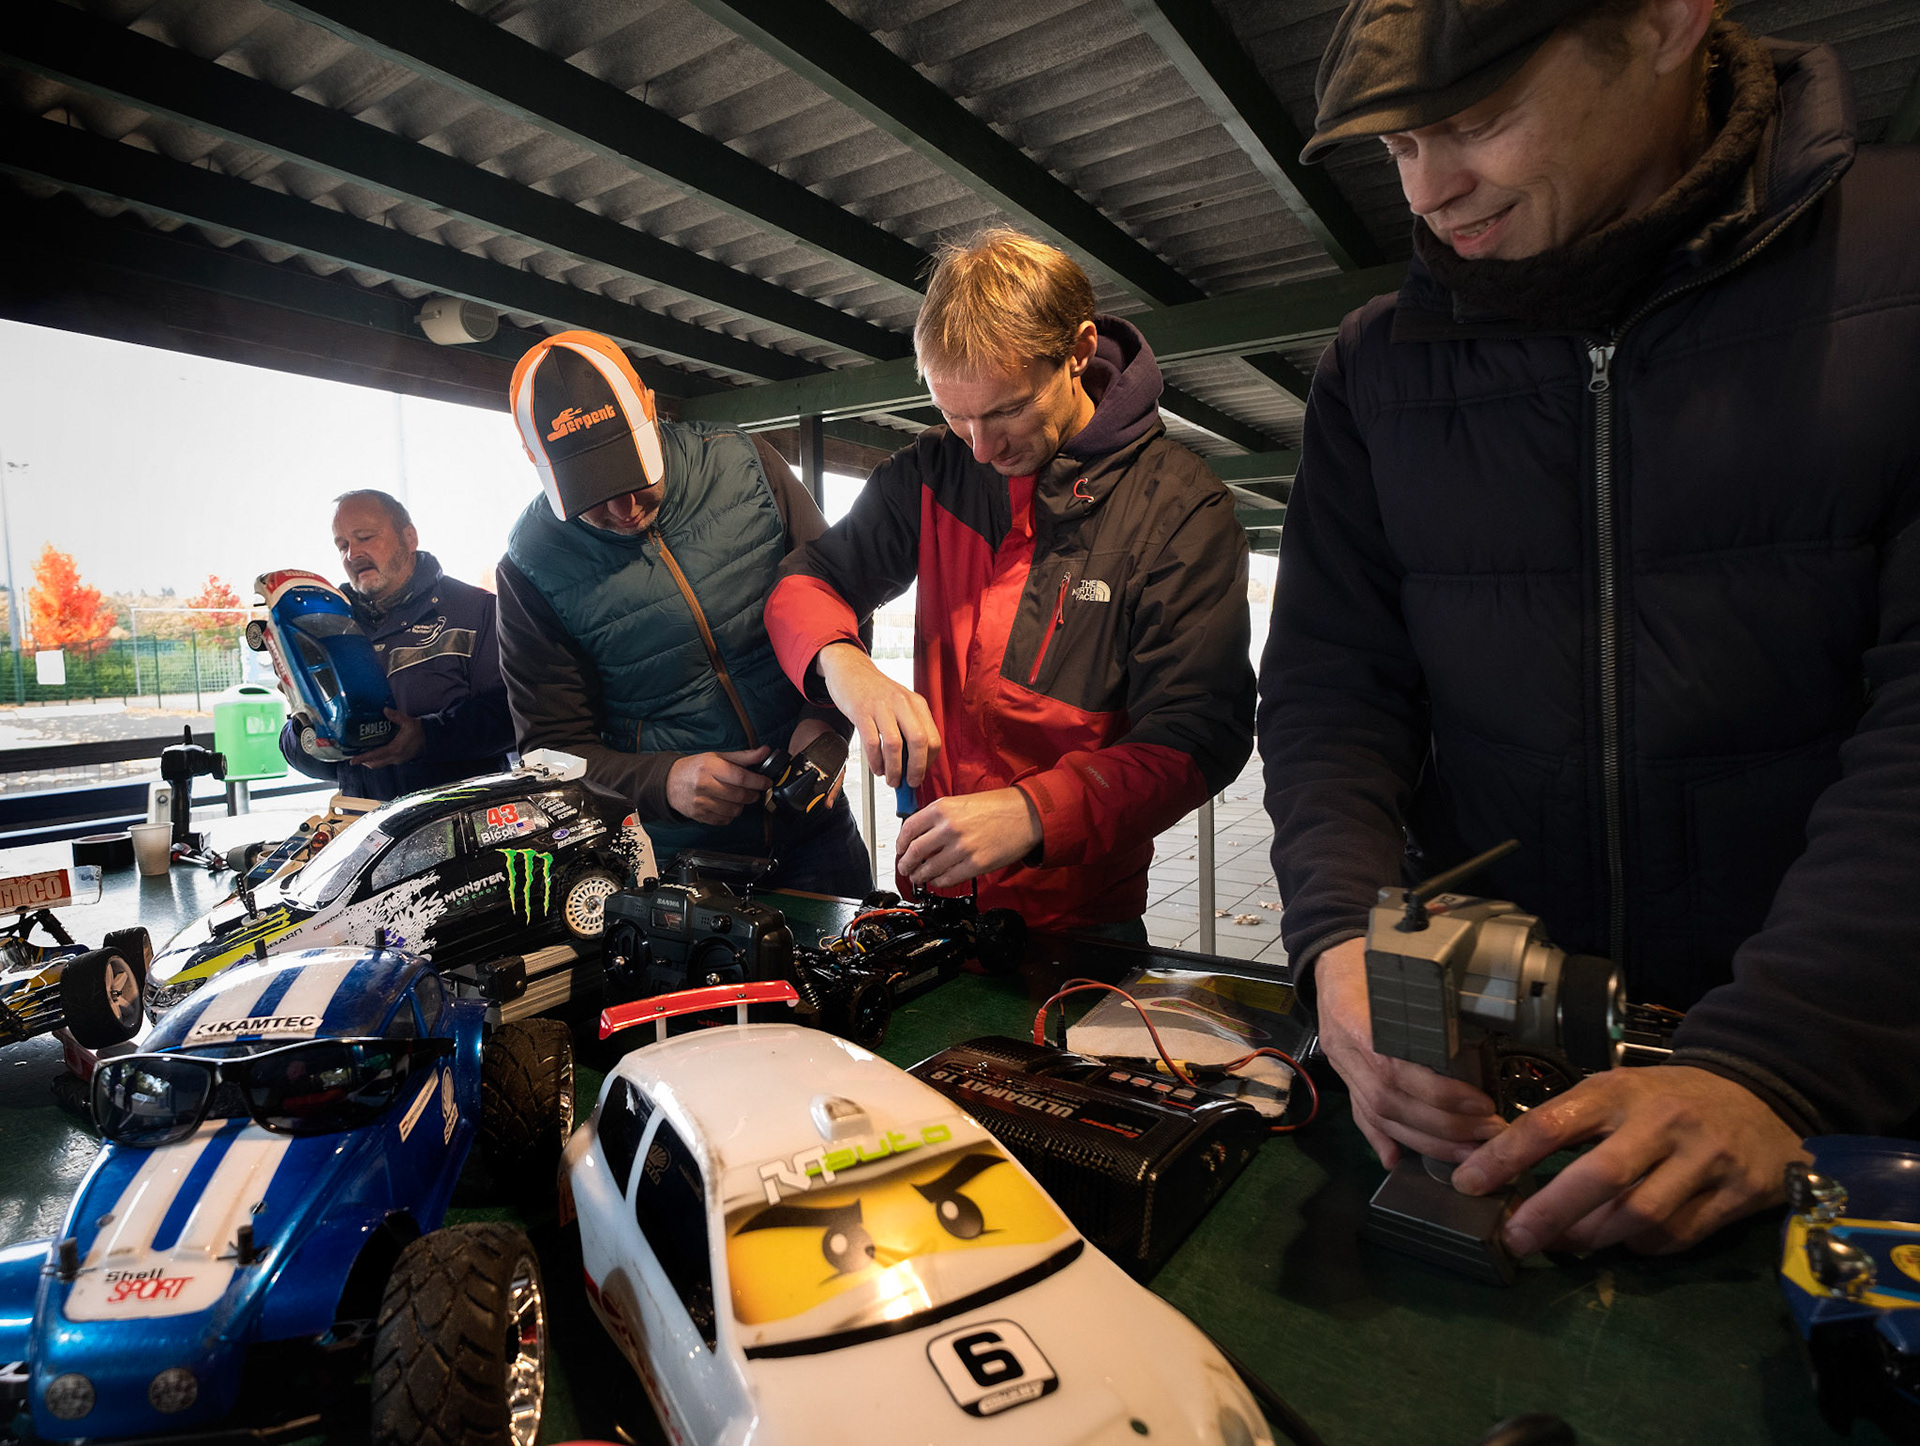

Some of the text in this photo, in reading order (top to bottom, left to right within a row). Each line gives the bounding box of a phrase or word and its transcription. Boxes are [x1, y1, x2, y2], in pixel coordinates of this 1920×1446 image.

[547, 404, 616, 442] Serpent
[1081, 579, 1097, 588] THE
[360, 720, 392, 736] ENDLESS
[487, 804, 519, 828] 43
[443, 871, 506, 903] MONSTER
[216, 1015, 316, 1033] KAMTEC
[930, 1070, 958, 1083] 18
[958, 1079, 1074, 1118] ULTRAMAT
[105, 1267, 165, 1284] Shell
[106, 1276, 195, 1303] SPORT
[952, 1331, 1025, 1388] 6
